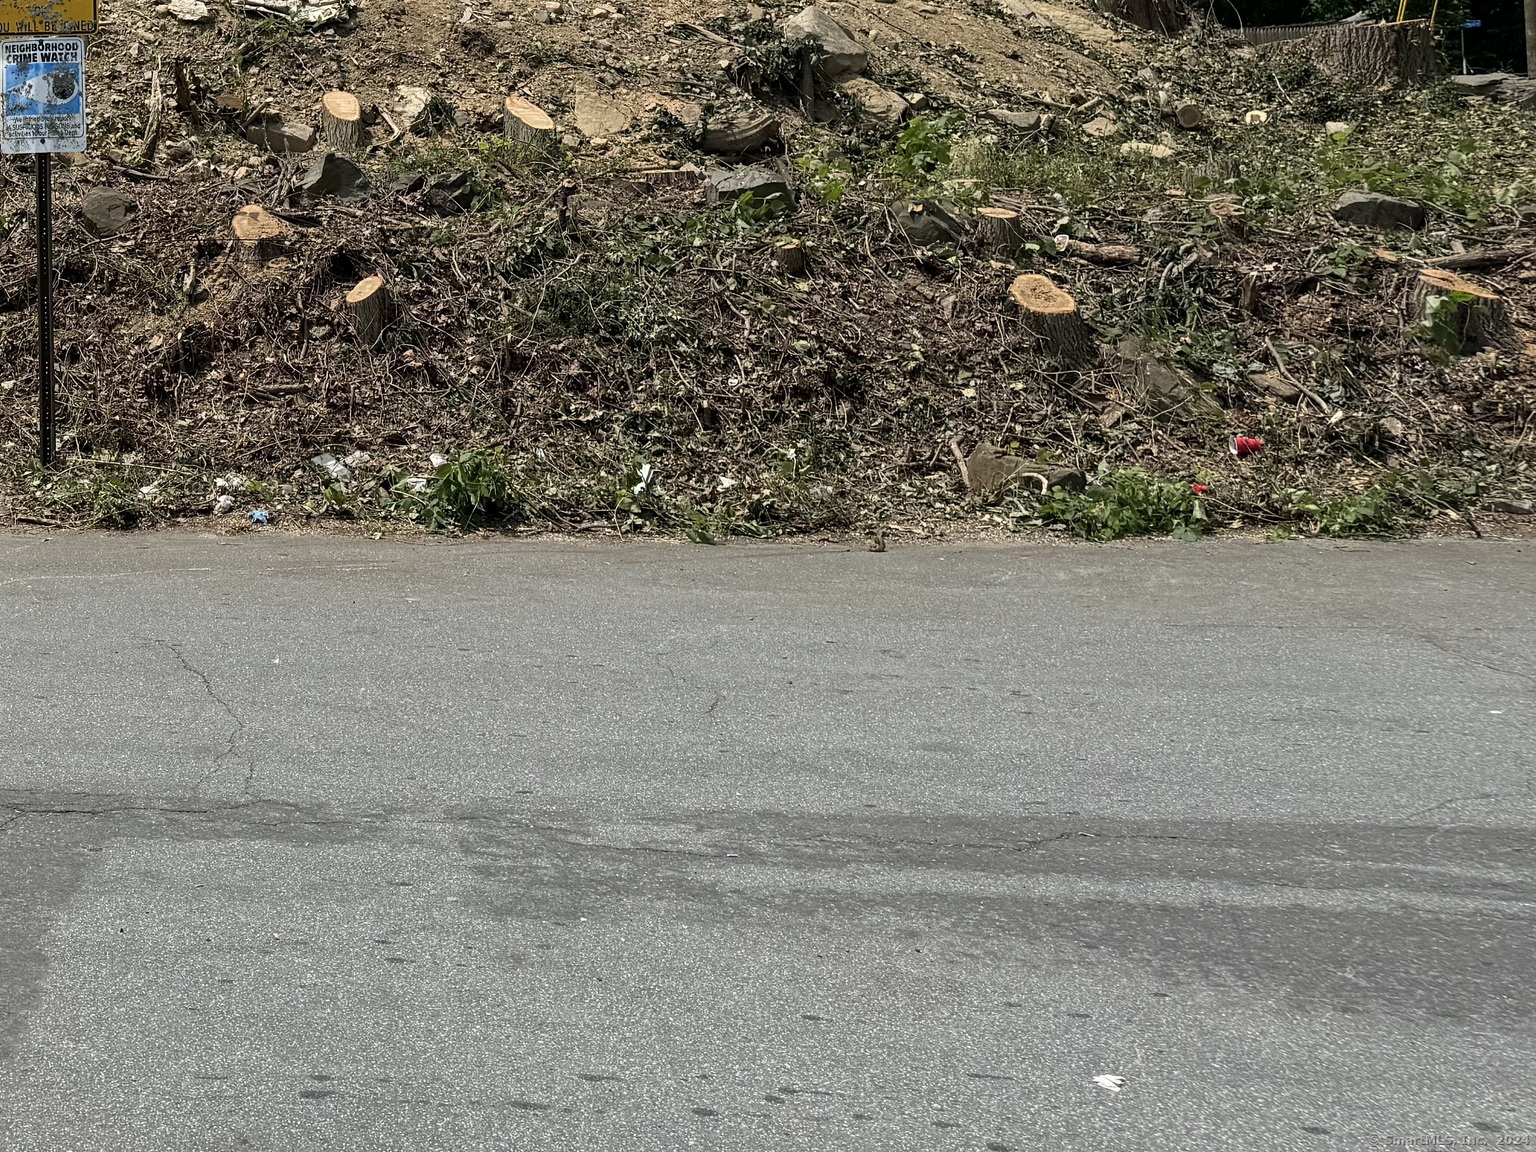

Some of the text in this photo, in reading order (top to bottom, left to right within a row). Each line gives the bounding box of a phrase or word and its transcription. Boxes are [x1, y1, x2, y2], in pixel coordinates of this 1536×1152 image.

[15, 21, 39, 32] WILL
[44, 21, 57, 31] BE
[5, 42, 79, 53] NEIGHBORHOOD
[6, 52, 77, 63] CRIME WATCH
